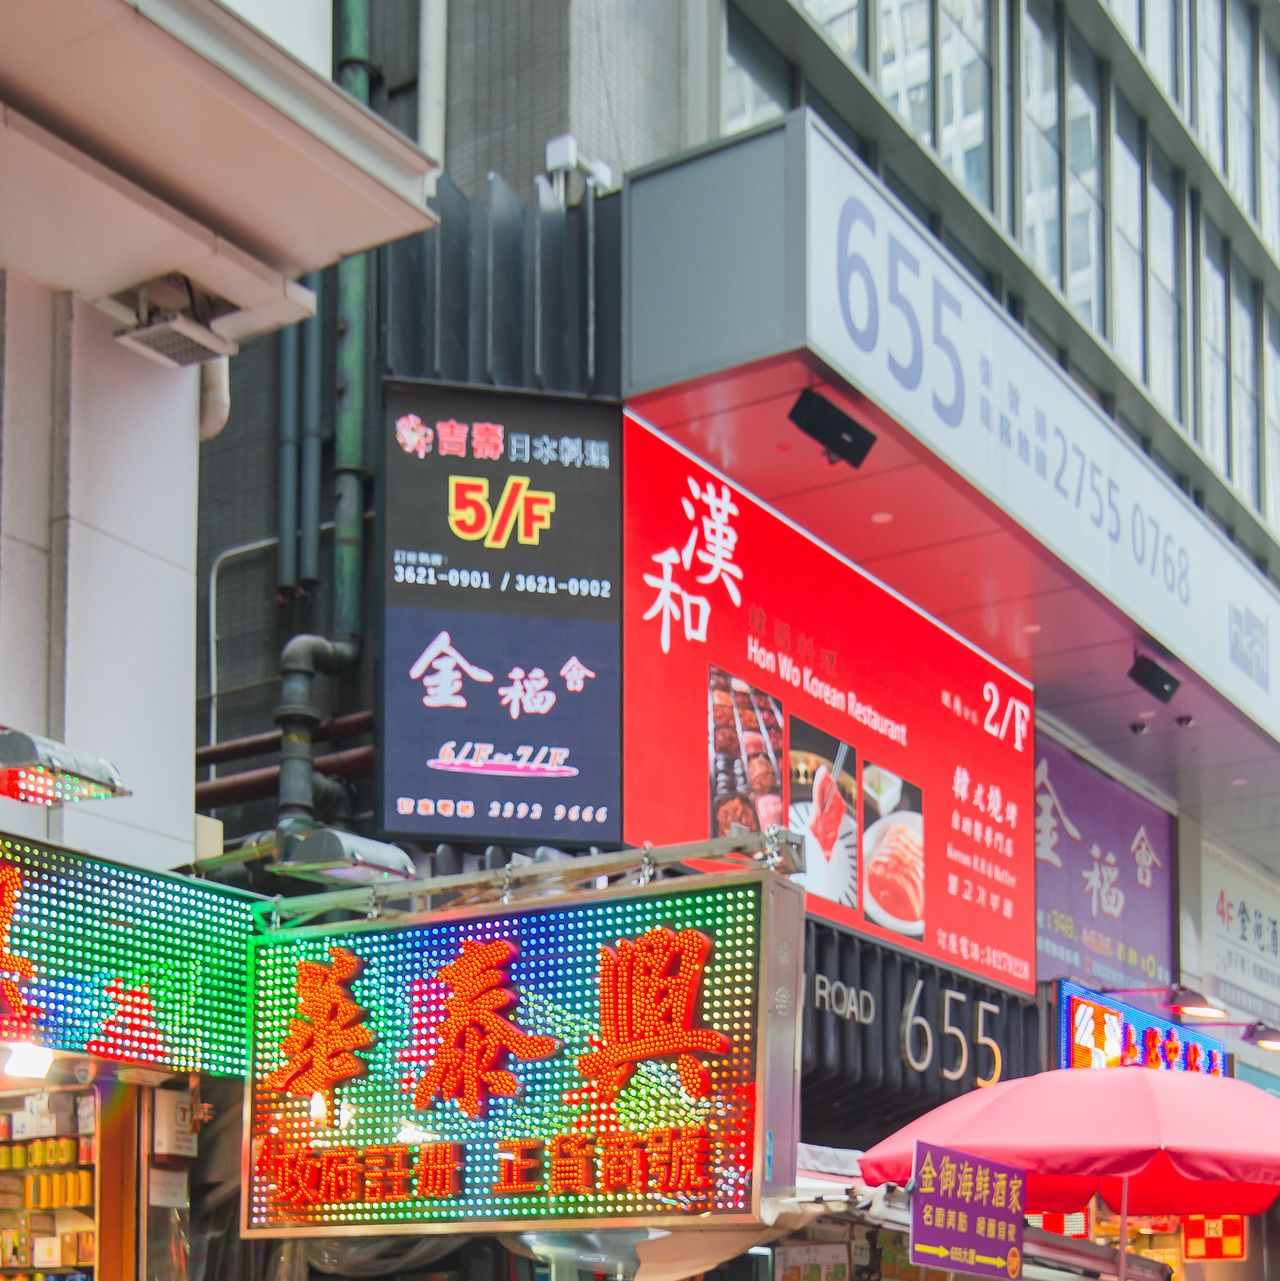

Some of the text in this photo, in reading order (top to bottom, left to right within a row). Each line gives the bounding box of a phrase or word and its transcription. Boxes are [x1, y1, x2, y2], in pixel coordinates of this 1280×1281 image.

[837, 196, 965, 430] 655
[1053, 426, 1120, 546] 2755
[1129, 502, 1190, 609] 0768
[447, 474, 556, 549] 5/F
[642, 475, 745, 656] 漢和
[393, 564, 492, 590] 3621-0901
[515, 573, 612, 599] 3621-0902
[746, 635, 776, 675] Hon
[777, 650, 801, 687] Wo
[803, 671, 845, 713] Korean
[846, 691, 908, 747] Restaurant
[983, 681, 1032, 753] 2/F
[814, 973, 876, 1025] ROAD
[900, 979, 1003, 1088] 655
